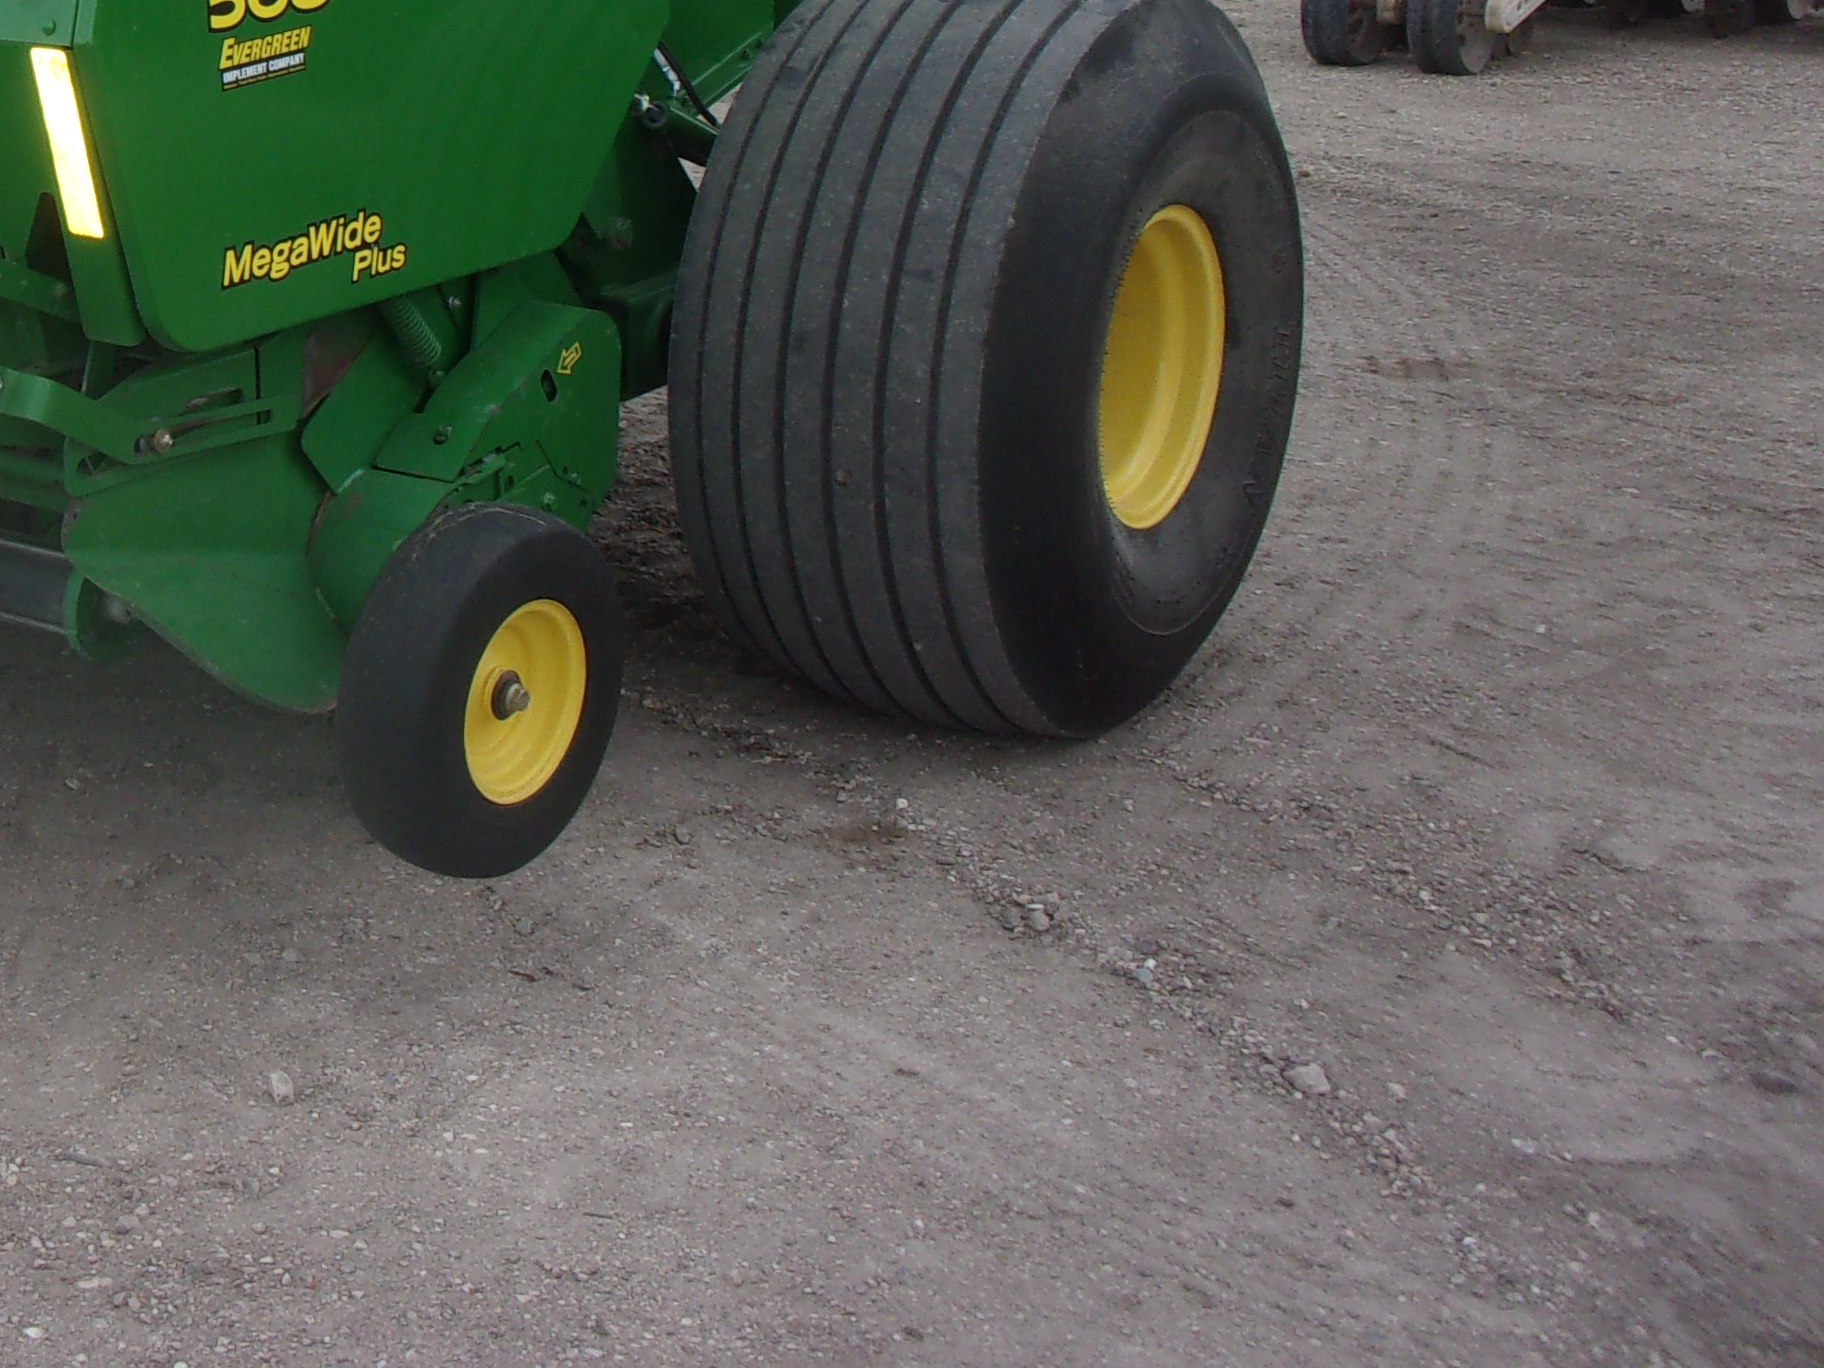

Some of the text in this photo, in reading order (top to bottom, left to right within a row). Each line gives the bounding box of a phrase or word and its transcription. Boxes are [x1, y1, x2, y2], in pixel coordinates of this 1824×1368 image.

[219, 26, 311, 69] EVERGREEN
[223, 62, 267, 84] IMPLEMENT
[268, 52, 305, 71] COMPANY
[223, 210, 382, 287] MegaWide
[352, 244, 407, 282] Plus
